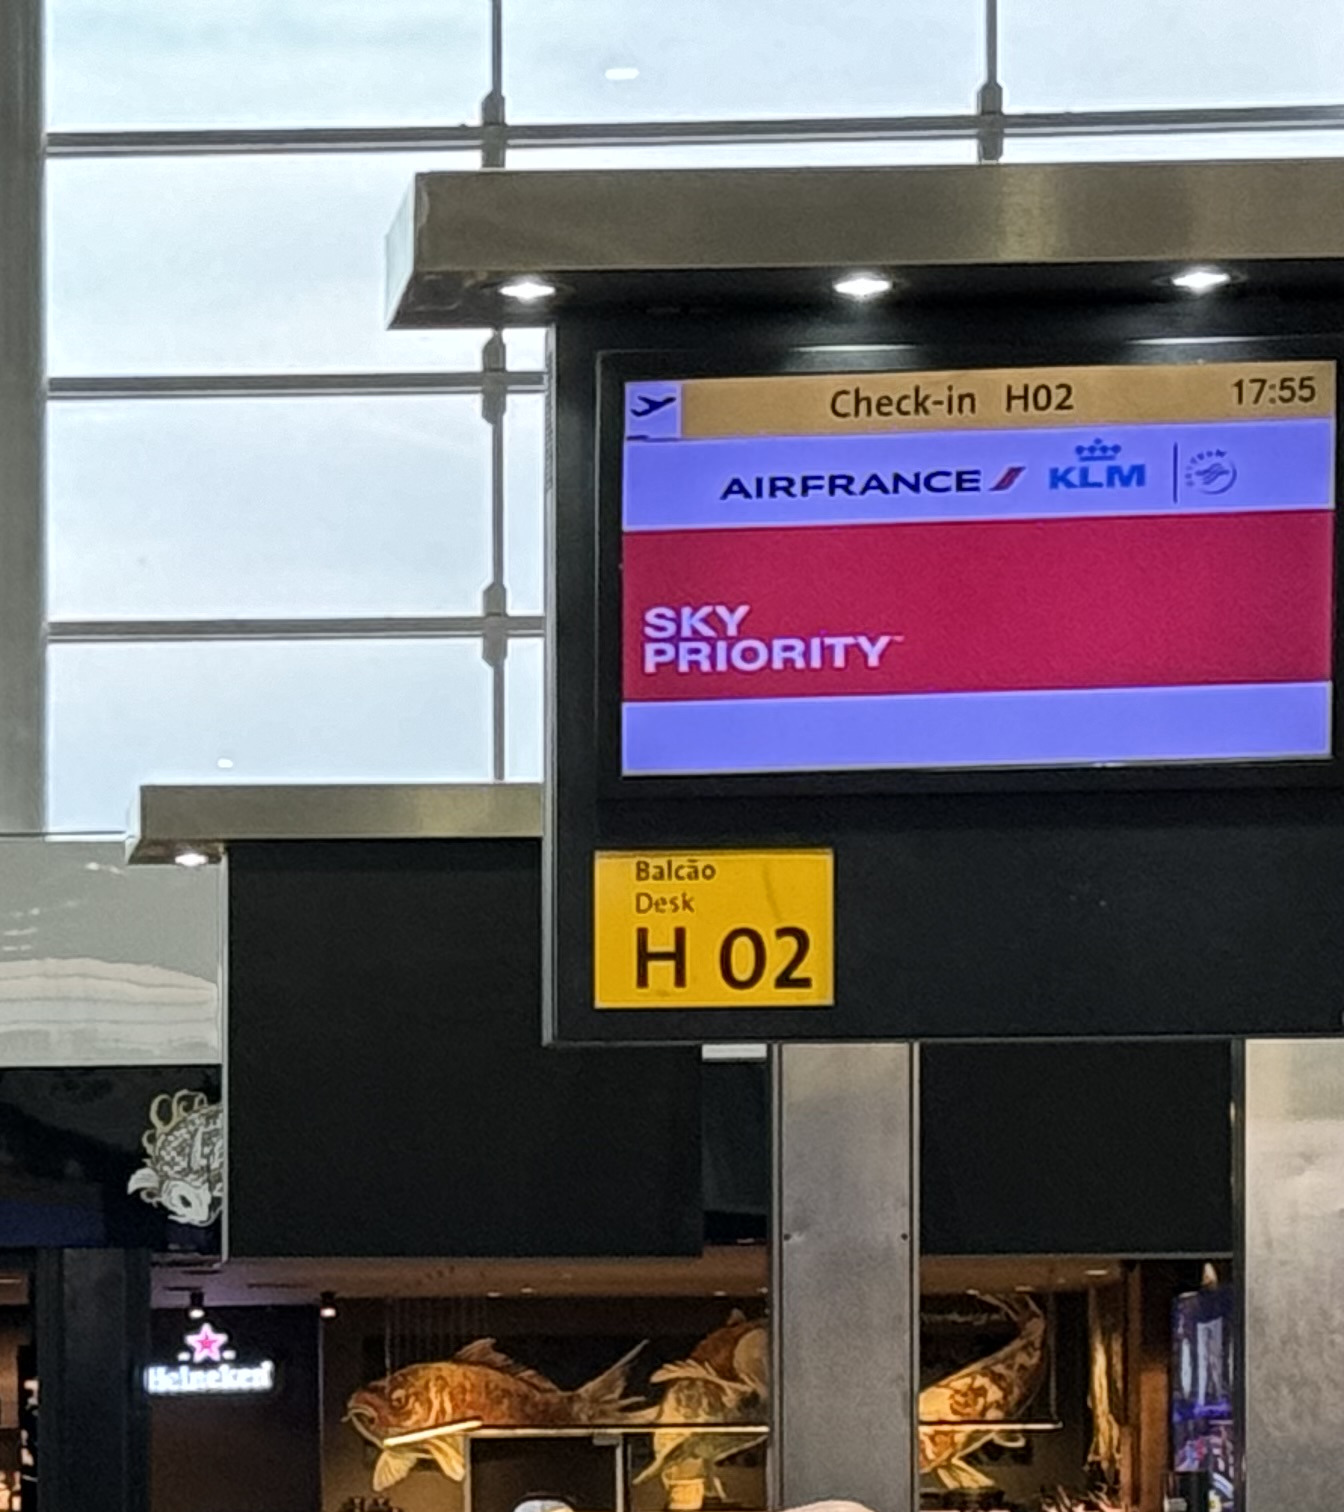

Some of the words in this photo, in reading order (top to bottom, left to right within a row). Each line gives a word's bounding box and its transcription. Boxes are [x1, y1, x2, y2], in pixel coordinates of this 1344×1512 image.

[829, 386, 977, 419] Check-in
[1005, 384, 1075, 413] H02
[1230, 377, 1318, 407] 17:55
[719, 469, 983, 501] AIRFRANCE
[1049, 464, 1146, 489] KLM
[643, 605, 751, 639] SKY
[643, 634, 891, 674] PRIORITY
[634, 859, 717, 884] Balcão
[634, 892, 696, 915] Desk
[635, 926, 688, 989] H
[718, 925, 814, 991] 02
